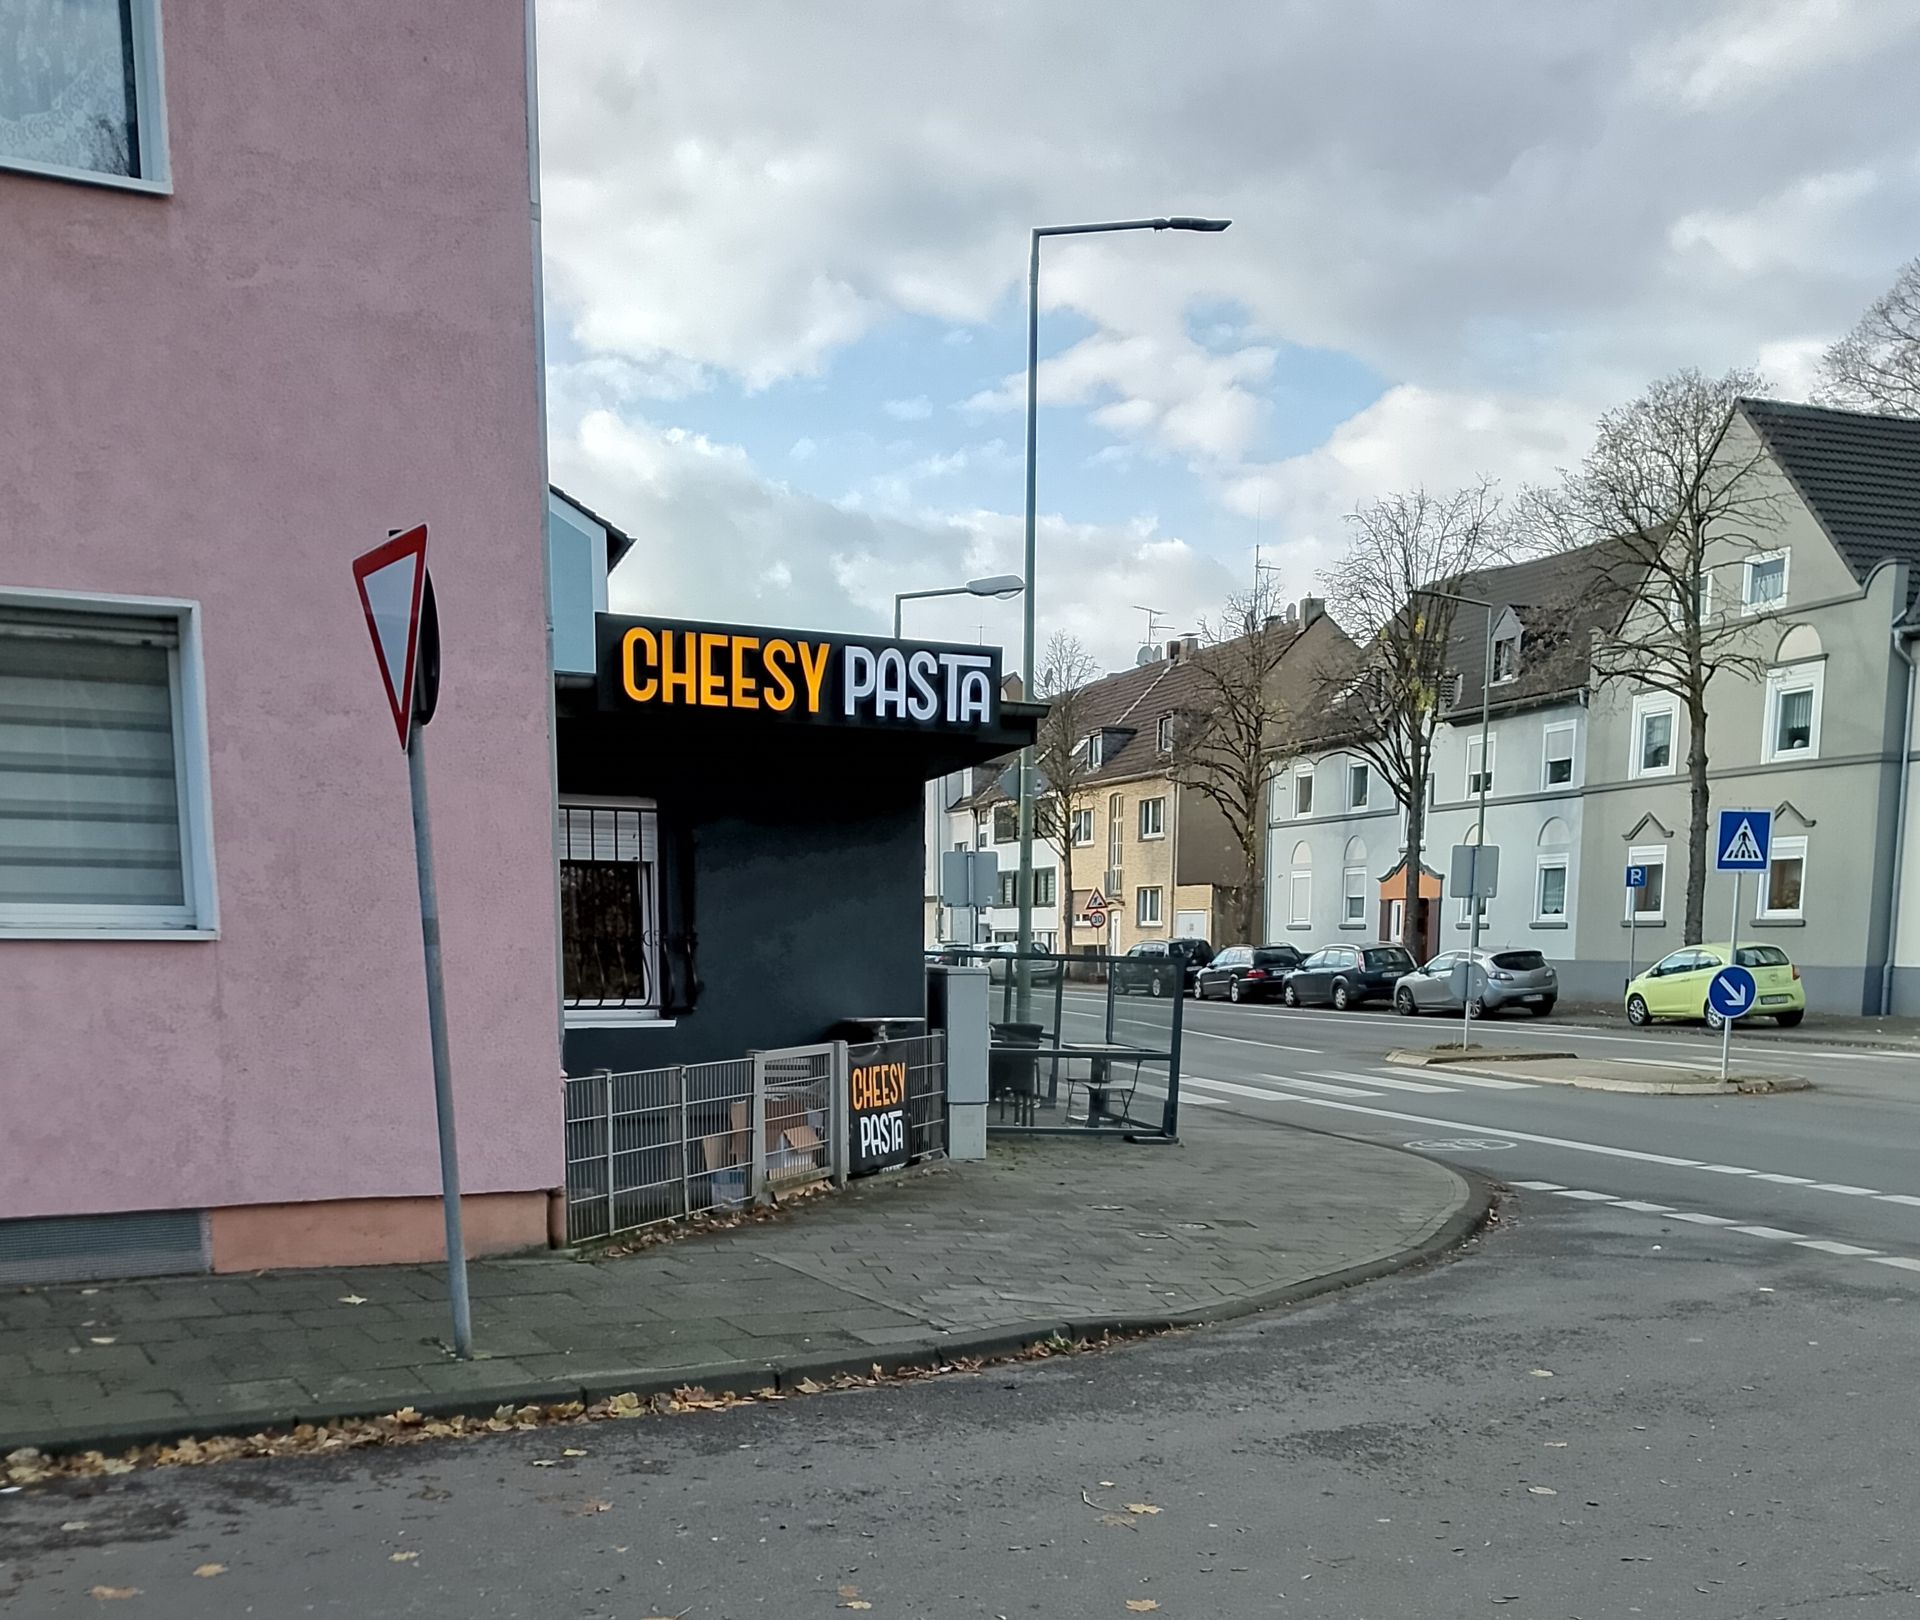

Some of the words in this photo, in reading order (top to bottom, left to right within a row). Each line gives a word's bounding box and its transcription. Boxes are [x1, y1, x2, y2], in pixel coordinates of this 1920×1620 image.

[622, 627, 830, 712] CHEESY
[845, 645, 991, 723] PASTA
[1093, 915, 1103, 924] 30
[852, 1062, 906, 1110] CHEESY
[860, 1110, 904, 1158] PASTA
